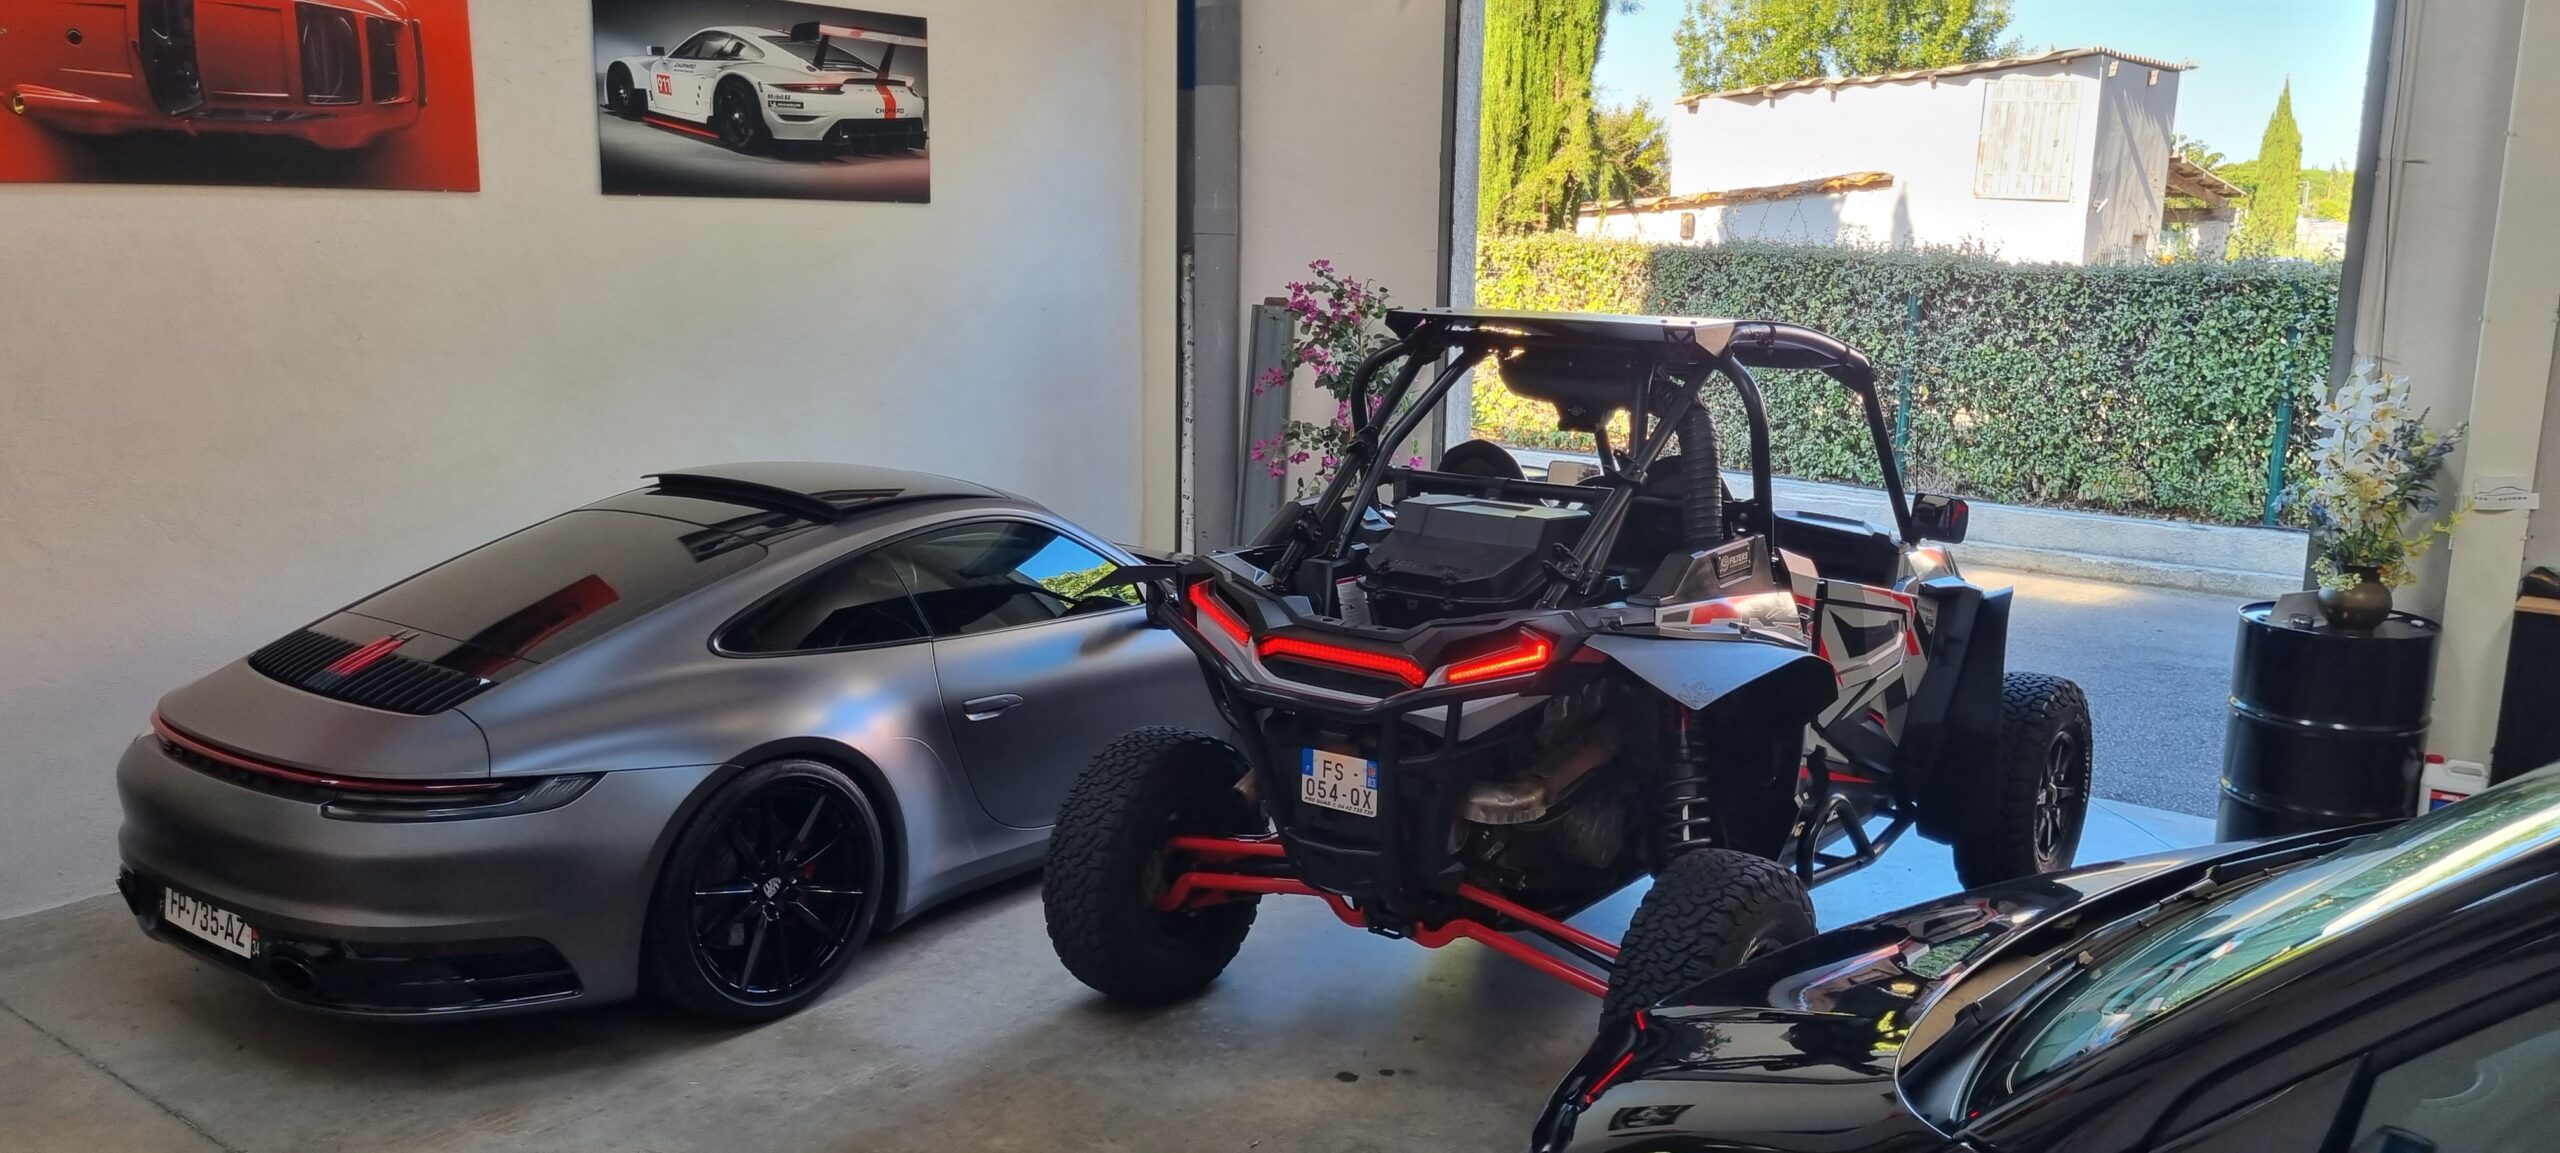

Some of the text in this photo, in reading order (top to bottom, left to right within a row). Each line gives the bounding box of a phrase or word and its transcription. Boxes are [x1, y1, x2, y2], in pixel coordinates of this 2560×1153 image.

[657, 76, 672, 93] 911
[1323, 760, 1344, 781] FS
[1367, 777, 1376, 788] 83
[1306, 778, 1371, 810] 054-QX
[171, 891, 245, 948] FP-735-AZ
